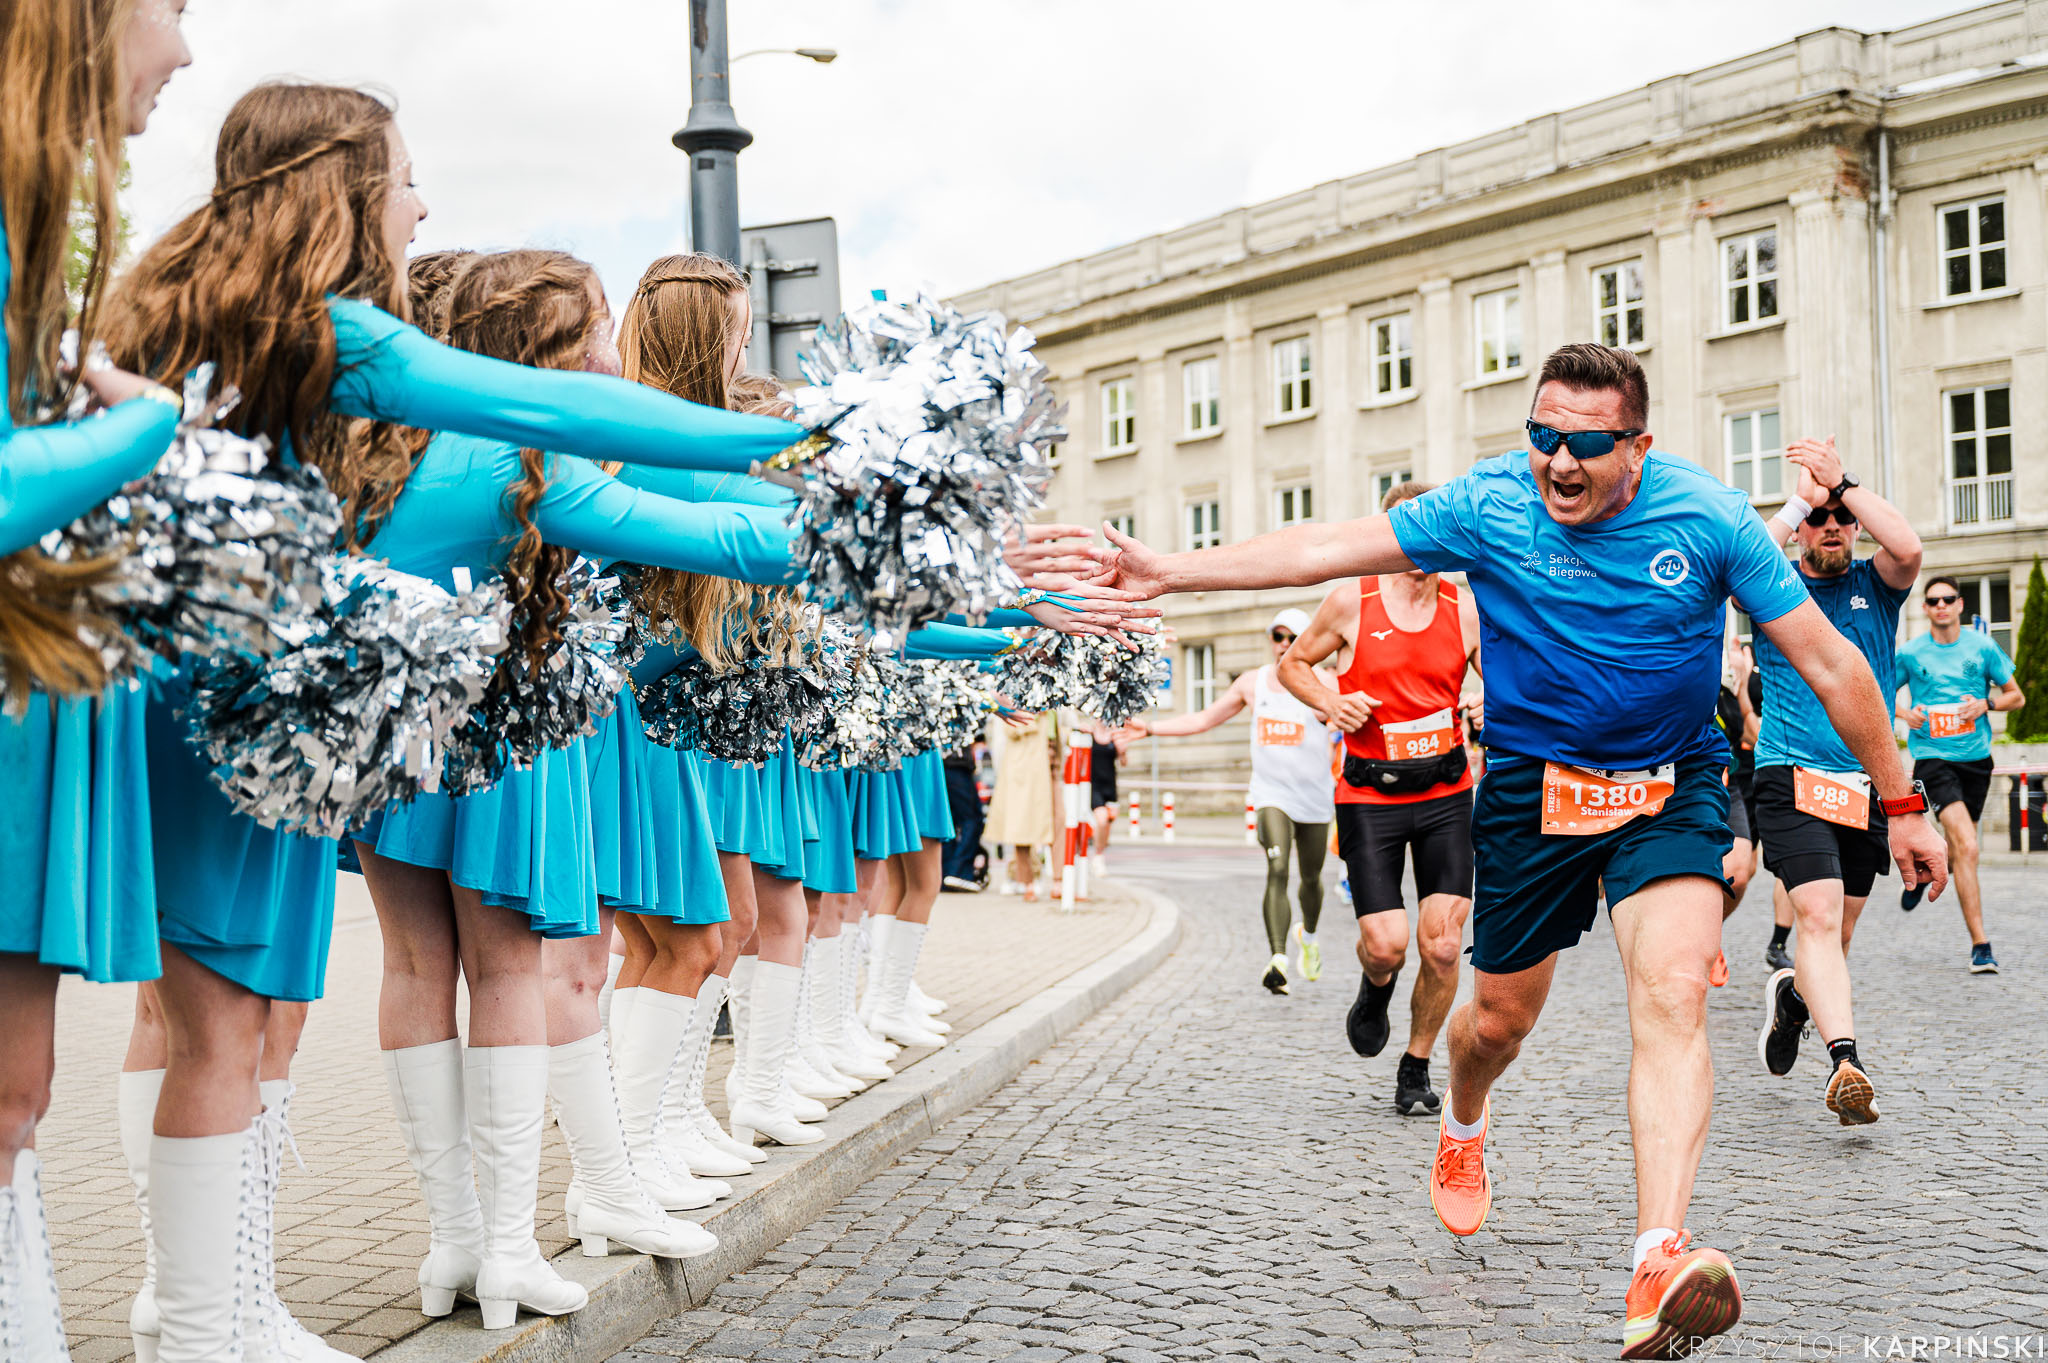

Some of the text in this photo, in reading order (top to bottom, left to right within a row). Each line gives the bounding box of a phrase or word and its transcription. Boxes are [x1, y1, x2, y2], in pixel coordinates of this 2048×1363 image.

[1549, 554, 1586, 566] Sekcja
[1658, 560, 1681, 576] PZU
[1549, 567, 1597, 579] Biegowa
[1406, 733, 1440, 757] 984
[1547, 787, 1556, 814] STREFA
[1569, 782, 1648, 807] 1380
[1813, 785, 1849, 807] 988
[1580, 806, 1633, 817] Stanisław
